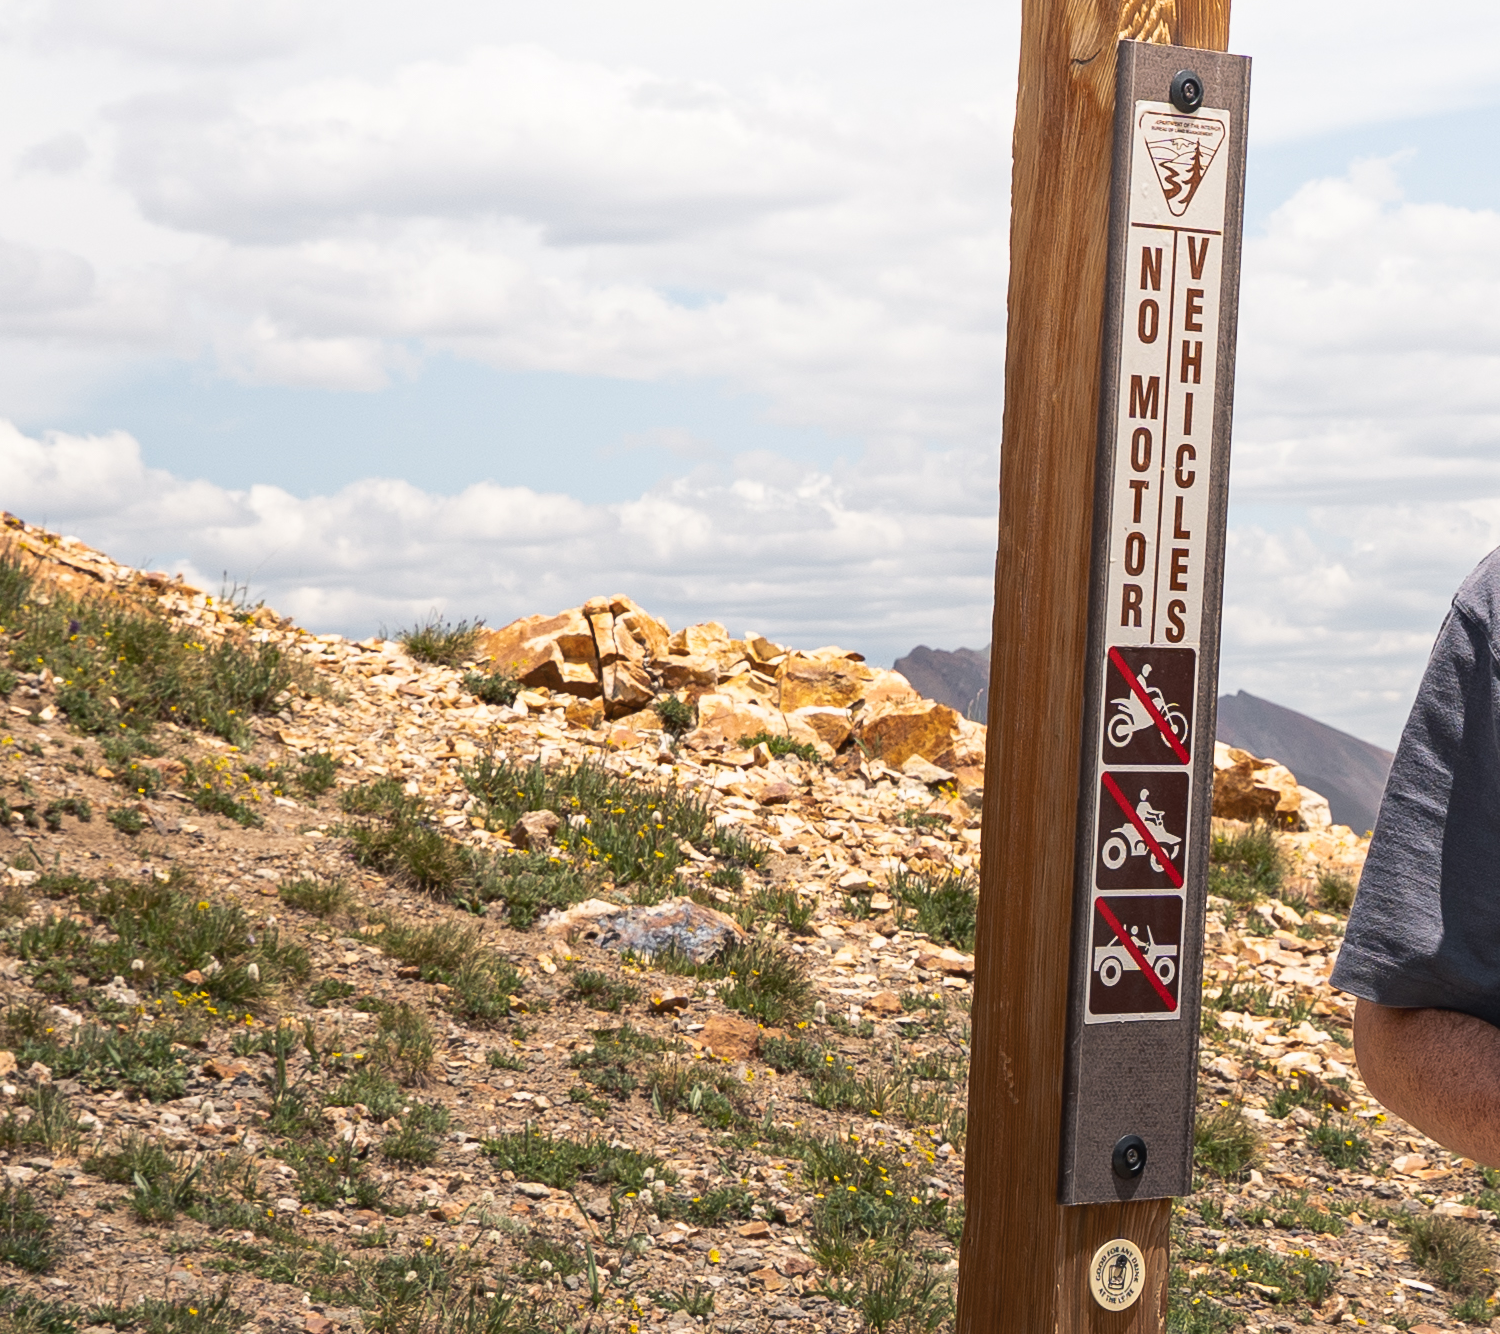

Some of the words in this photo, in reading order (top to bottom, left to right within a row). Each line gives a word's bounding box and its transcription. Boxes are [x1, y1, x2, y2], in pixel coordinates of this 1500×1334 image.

[1137, 246, 1163, 344] NO
[1165, 236, 1210, 643] VEHICLES
[1120, 374, 1160, 628] MOTOR
[1095, 1255, 1107, 1281] GOOD
[1107, 1246, 1120, 1256] FOR
[1121, 1247, 1133, 1257] ANY
[1131, 1256, 1140, 1283] DRINK
[1098, 1288, 1106, 1297] AT
[1105, 1295, 1117, 1304] THE
